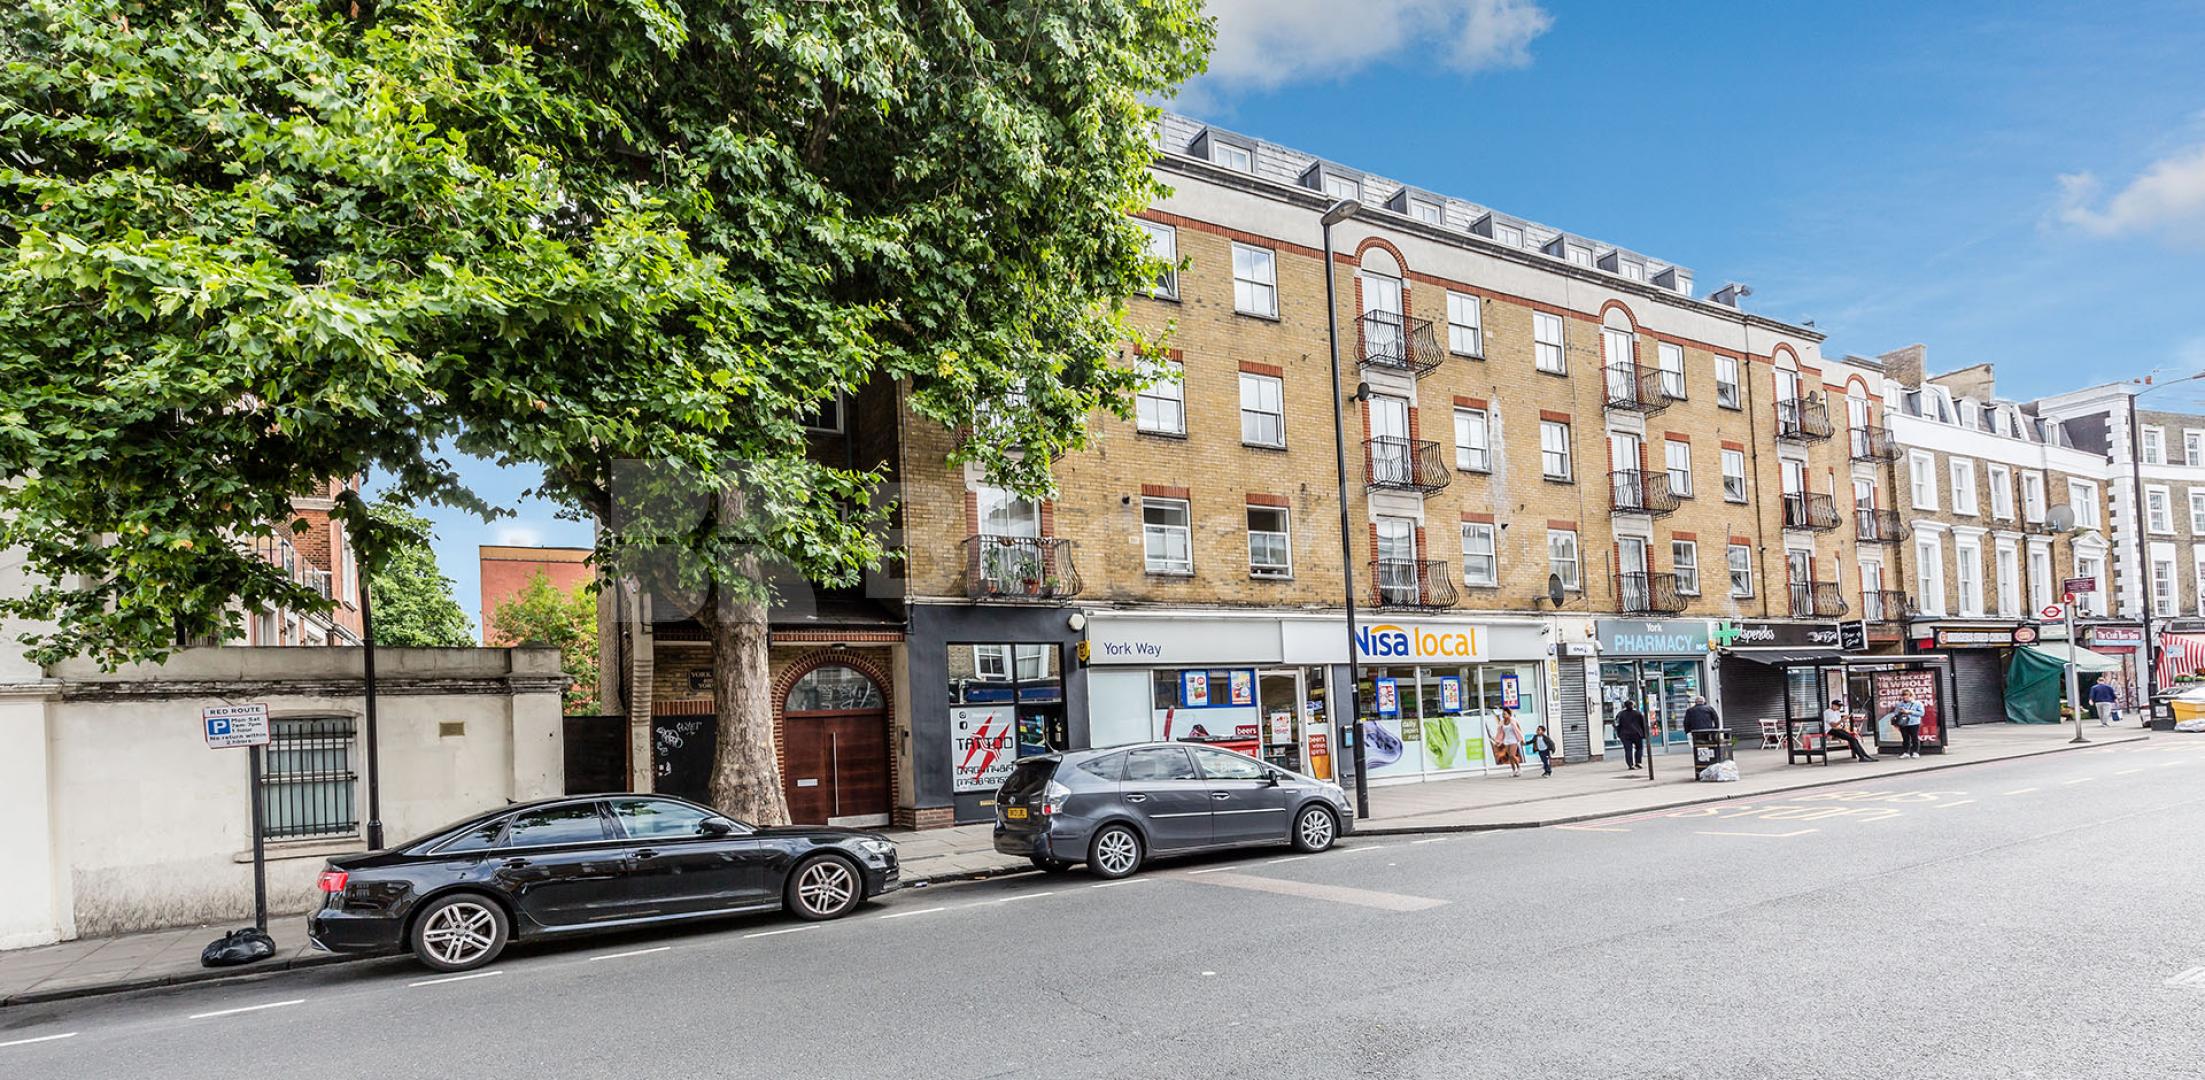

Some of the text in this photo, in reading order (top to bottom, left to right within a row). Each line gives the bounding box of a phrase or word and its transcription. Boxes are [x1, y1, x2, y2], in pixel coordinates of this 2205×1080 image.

[1645, 622, 1663, 632] York
[1355, 625, 1478, 656] Nisa local
[1614, 634, 1694, 651] PHARMACY
[1104, 642, 1162, 658] York Way
[213, 720, 228, 734] P
[1237, 725, 1257, 735] beers
[956, 736, 1013, 750] TATTOO
